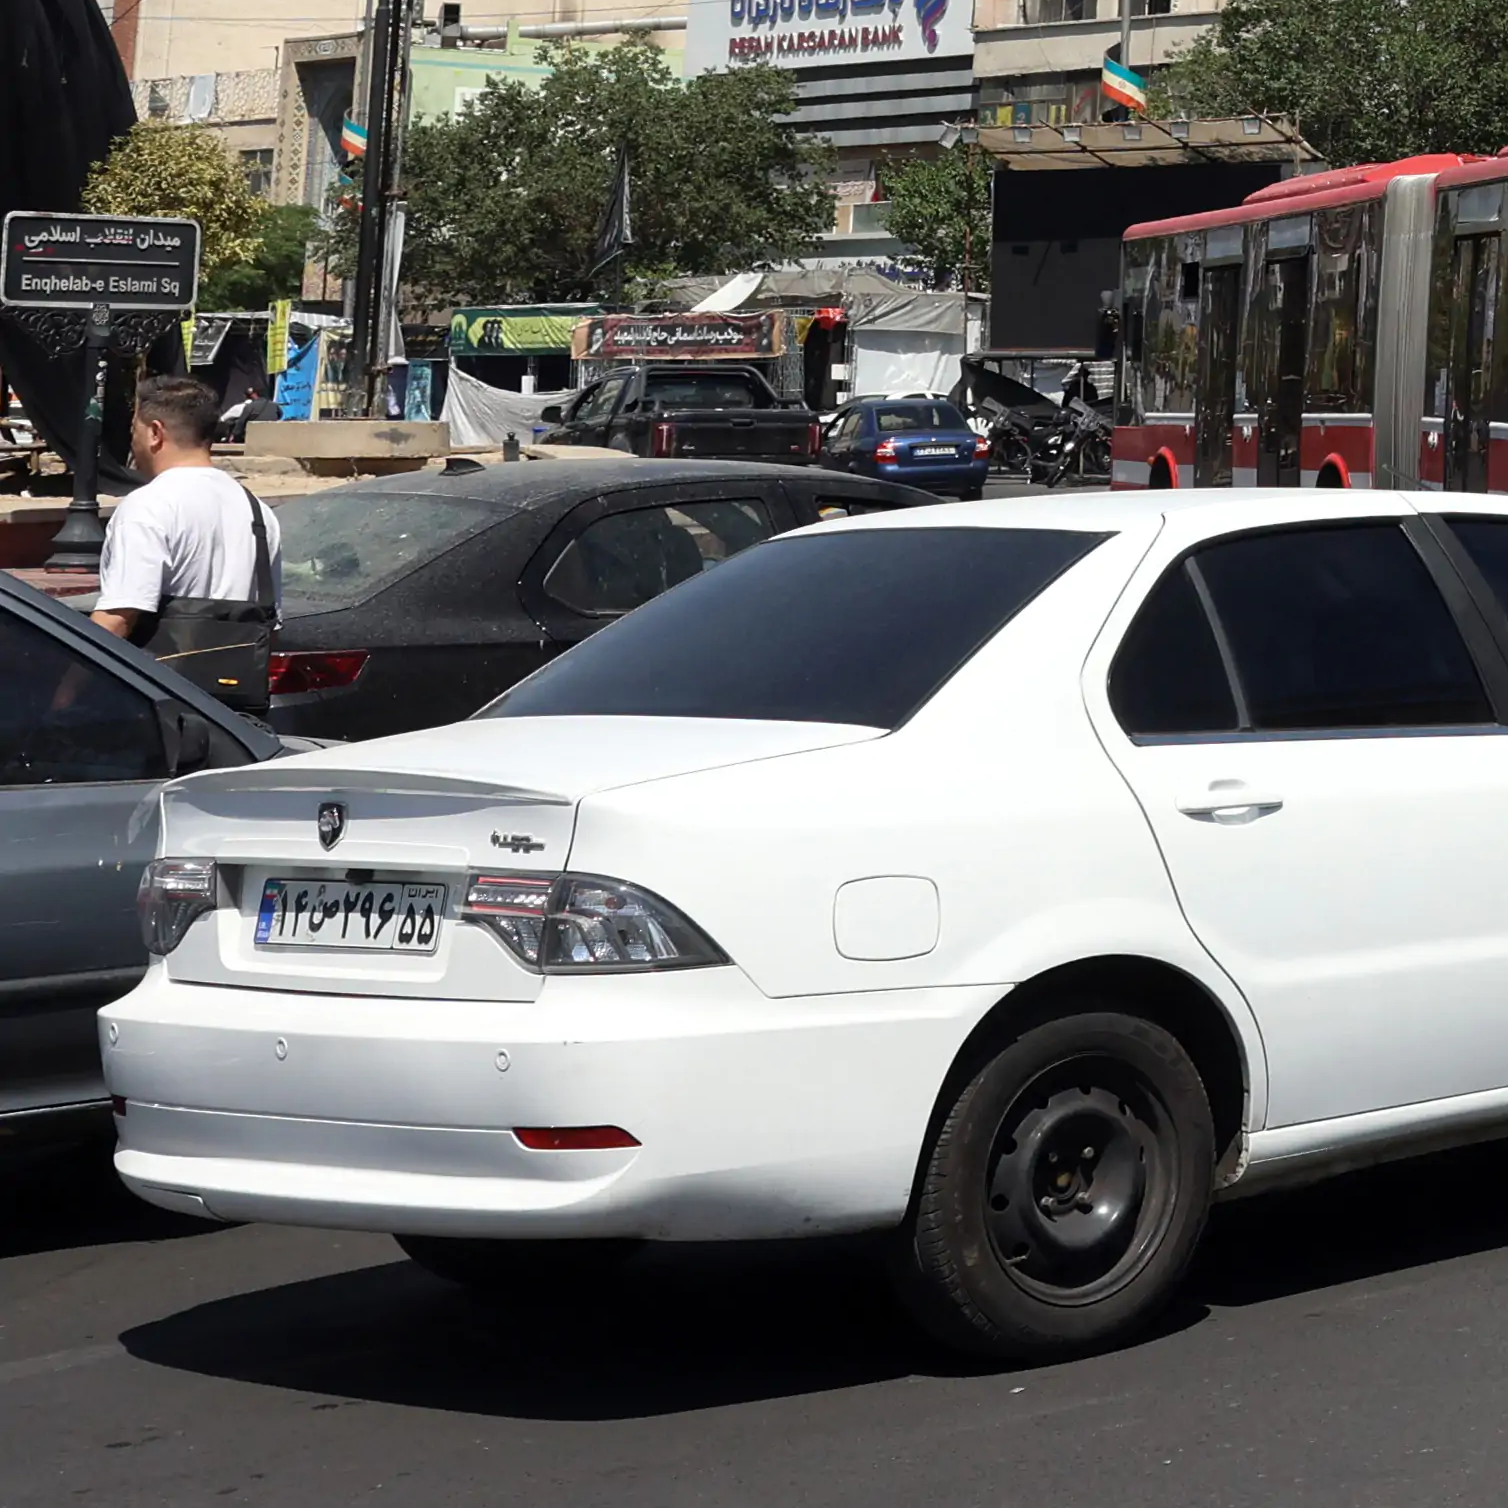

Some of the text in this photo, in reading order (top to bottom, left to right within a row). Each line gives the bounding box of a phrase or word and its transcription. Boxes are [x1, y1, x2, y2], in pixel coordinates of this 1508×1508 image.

[861, 24, 902, 46] BANK
[24, 225, 181, 252] میدان انقلاب اسلامی
[109, 277, 157, 293] Eslami
[161, 277, 180, 297] Sq
[407, 887, 439, 899] ایران
[398, 903, 435, 945] ۵۵
